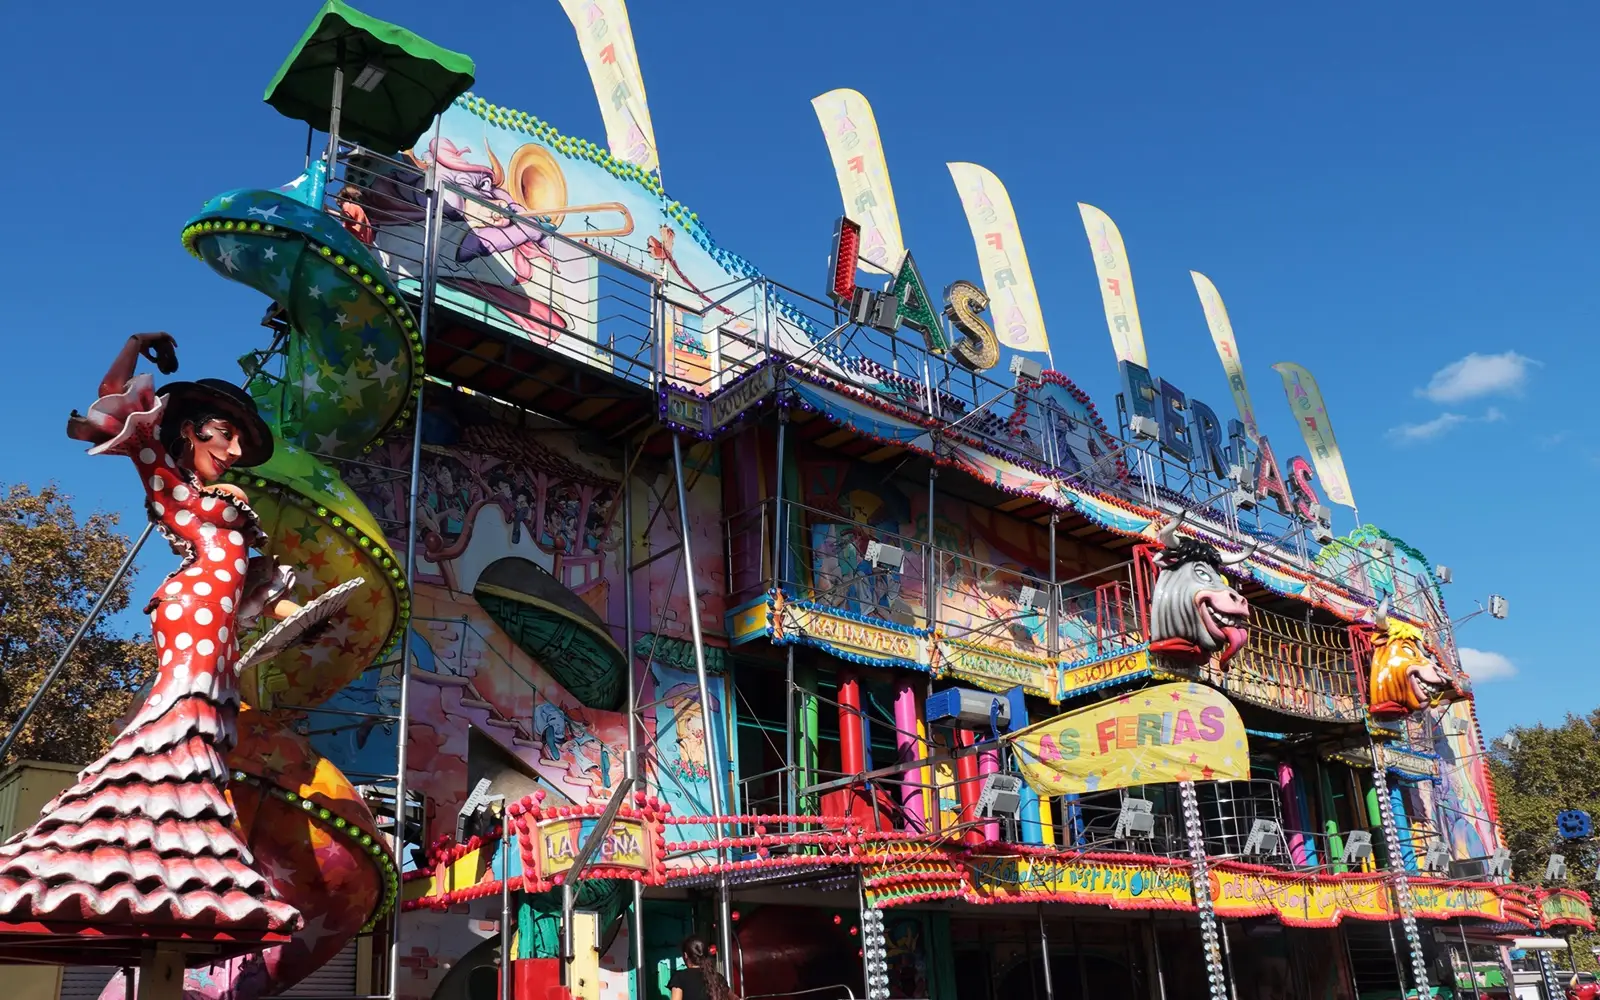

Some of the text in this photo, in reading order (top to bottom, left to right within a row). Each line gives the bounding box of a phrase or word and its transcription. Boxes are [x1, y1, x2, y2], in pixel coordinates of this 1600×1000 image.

[826, 214, 1322, 522] LAS FERIAS
[1095, 705, 1225, 755] FERIAS
[545, 834, 576, 860] LA
